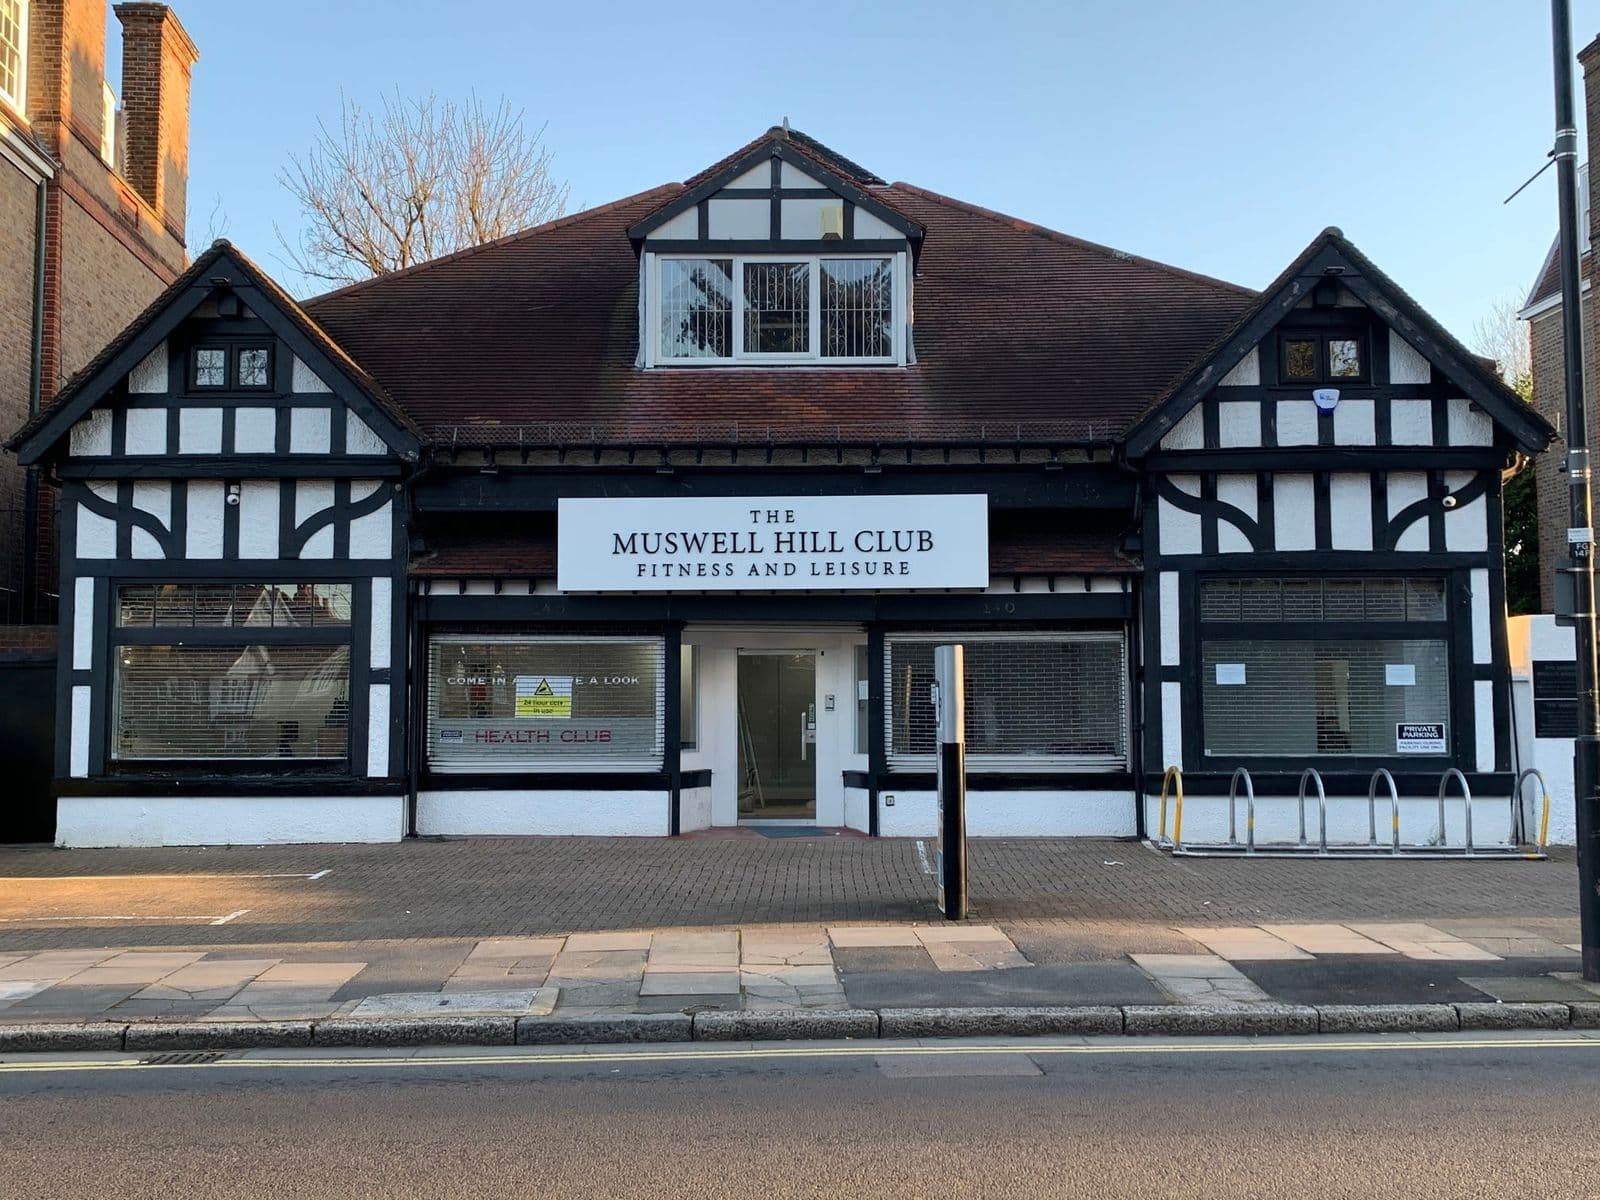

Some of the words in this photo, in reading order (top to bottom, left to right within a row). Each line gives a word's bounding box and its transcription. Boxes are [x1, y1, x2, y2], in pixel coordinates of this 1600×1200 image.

[749, 509, 795, 524] THE
[612, 531, 764, 555] MUSWELL
[773, 530, 845, 554] HILL
[854, 529, 935, 553] CLUB
[637, 563, 735, 578] FITNESS
[747, 562, 797, 577] AND
[810, 561, 911, 576] LEISURE
[447, 677, 486, 686] COME
[492, 677, 506, 686] IN
[589, 676, 599, 685] A
[604, 676, 640, 685] LOOK
[475, 730, 550, 743] HEALTH
[560, 730, 612, 743] CLUB
